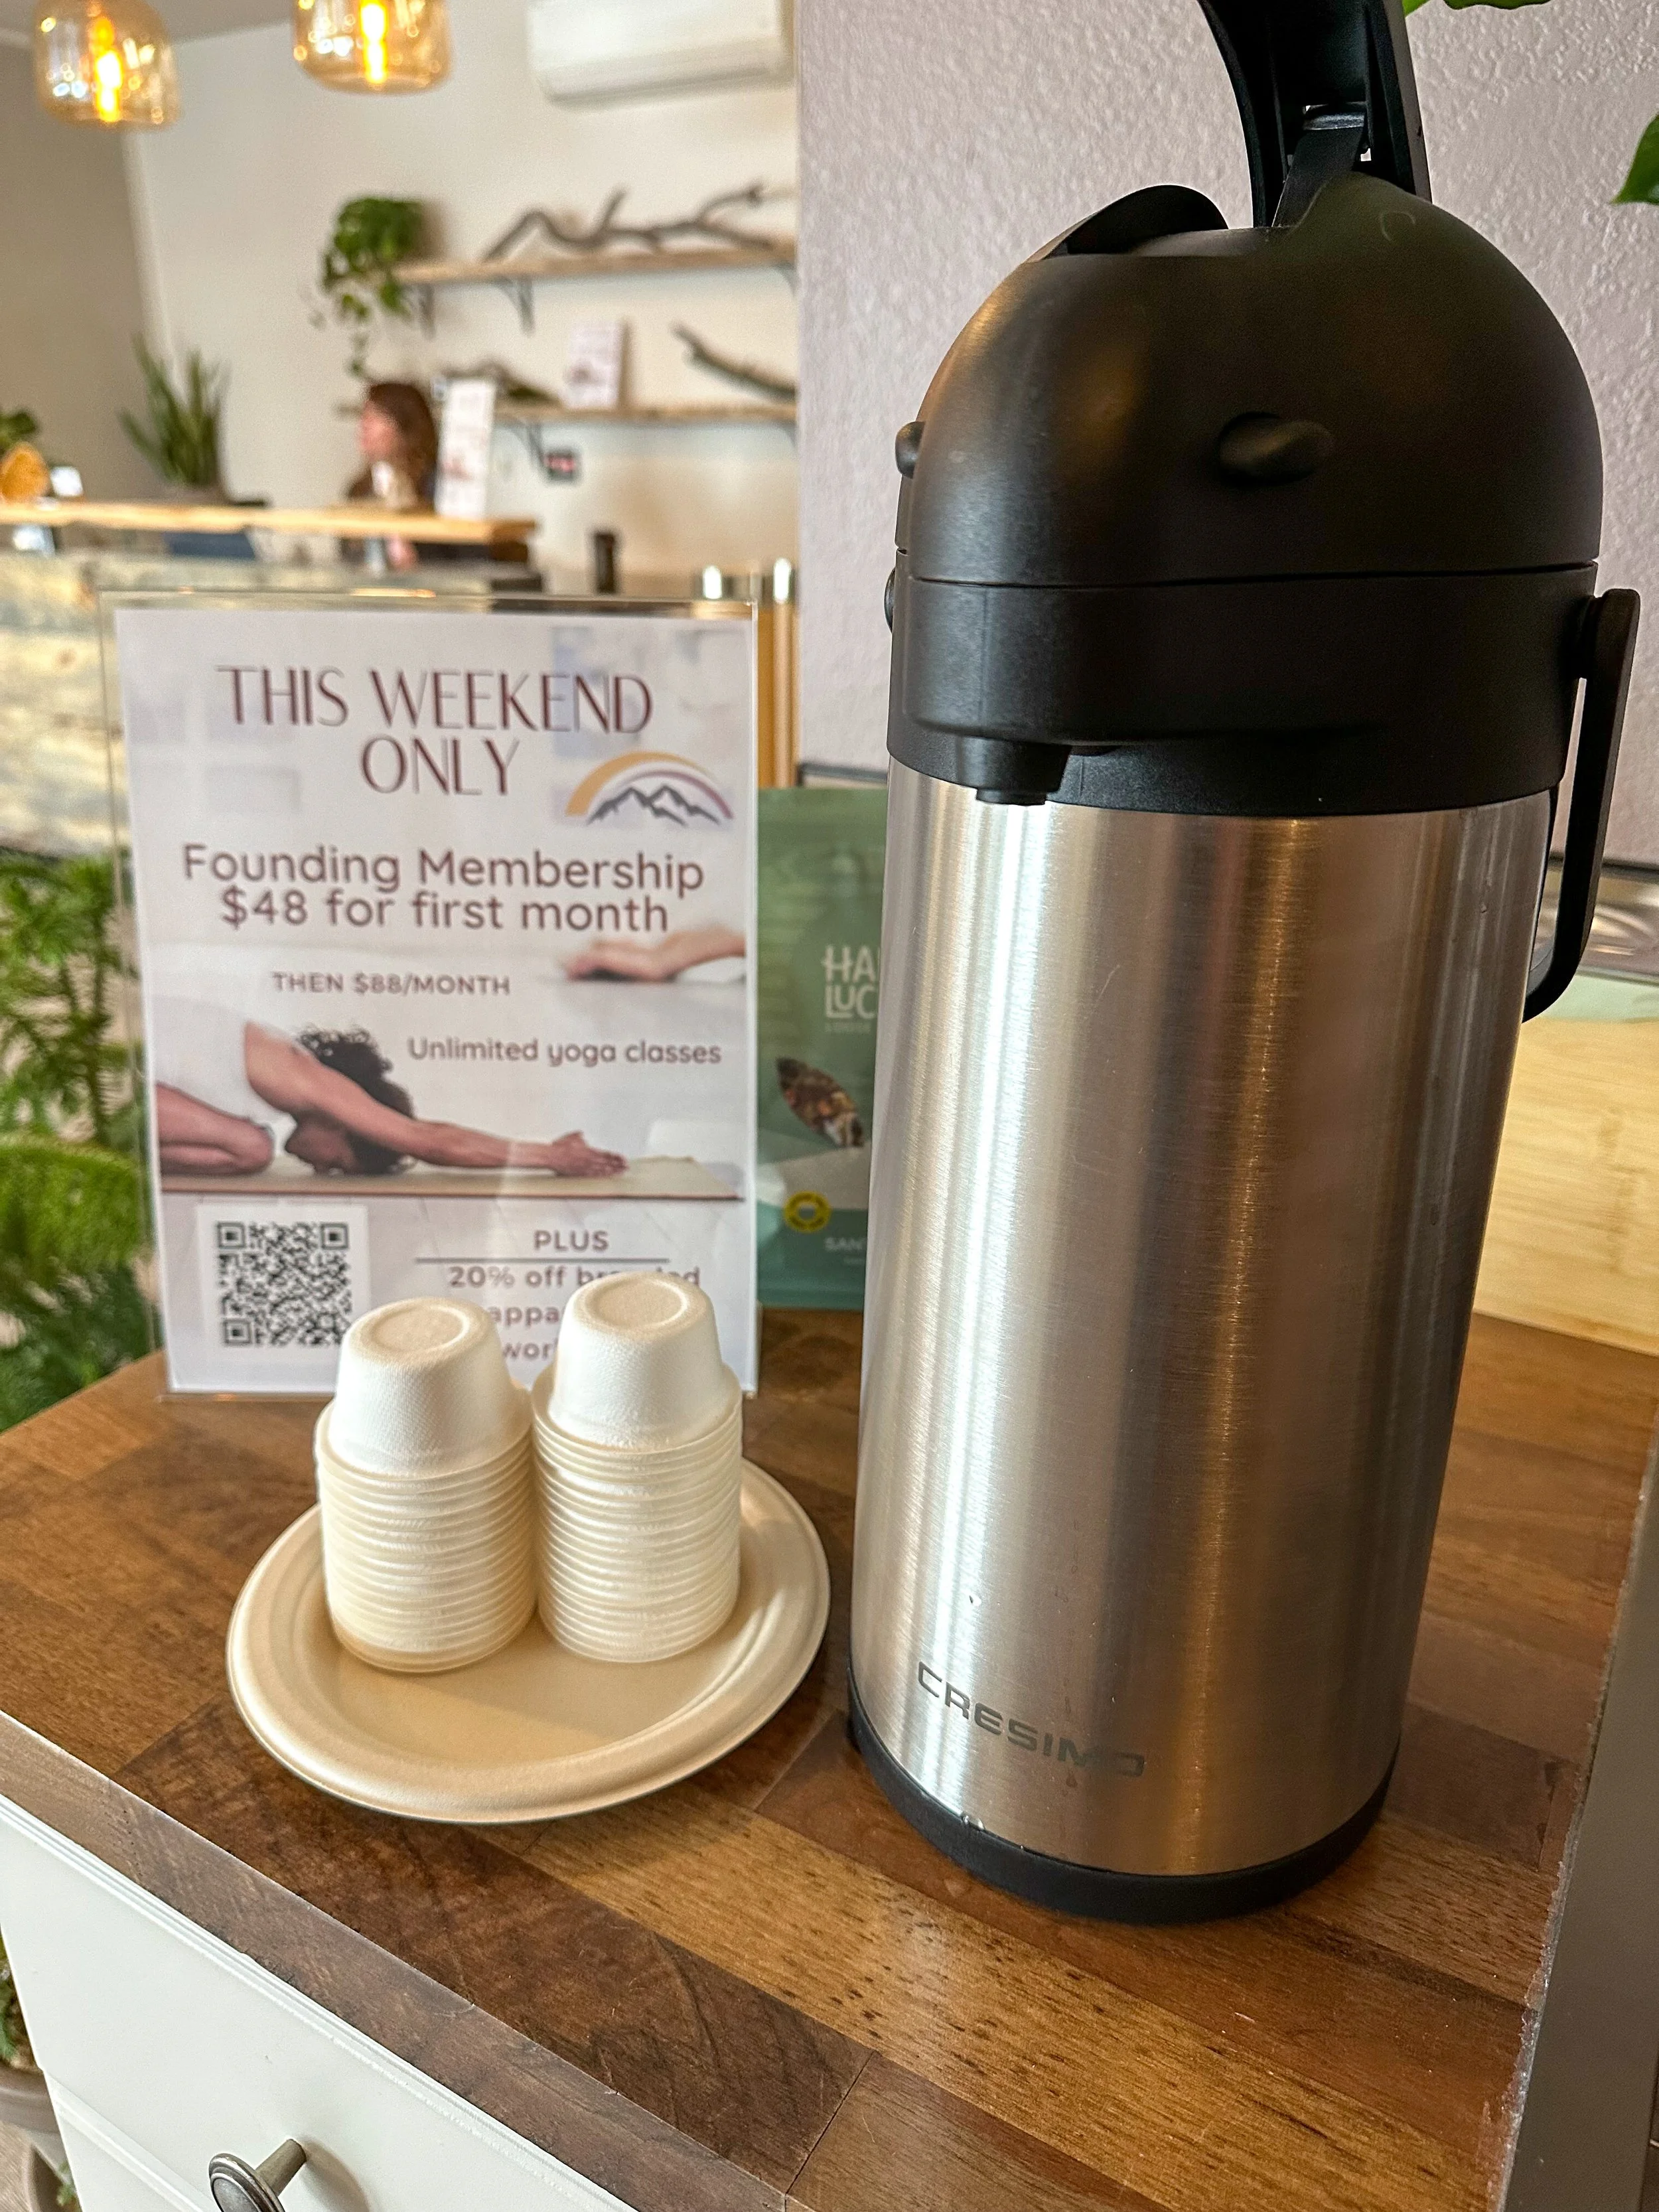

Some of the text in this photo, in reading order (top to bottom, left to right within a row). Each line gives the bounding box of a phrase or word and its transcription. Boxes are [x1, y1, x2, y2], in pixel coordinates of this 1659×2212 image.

[216, 665, 652, 733] THIS WEEKEND
[360, 735, 521, 796] ONLY
[183, 844, 704, 898] Founding Membership
[221, 885, 668, 932] $48 for first month
[819, 944, 881, 983] HA
[272, 971, 511, 996] THEN $88/MONTH
[407, 1037, 723, 1069] Unlimited yoga classes
[534, 1230, 610, 1252] PLUS
[449, 1266, 516, 1289] 20%
[525, 1266, 566, 1288] off
[489, 1306, 561, 1327] appa
[503, 1337, 559, 1360] wor
[918, 1660, 1146, 1777] CRESIMO
